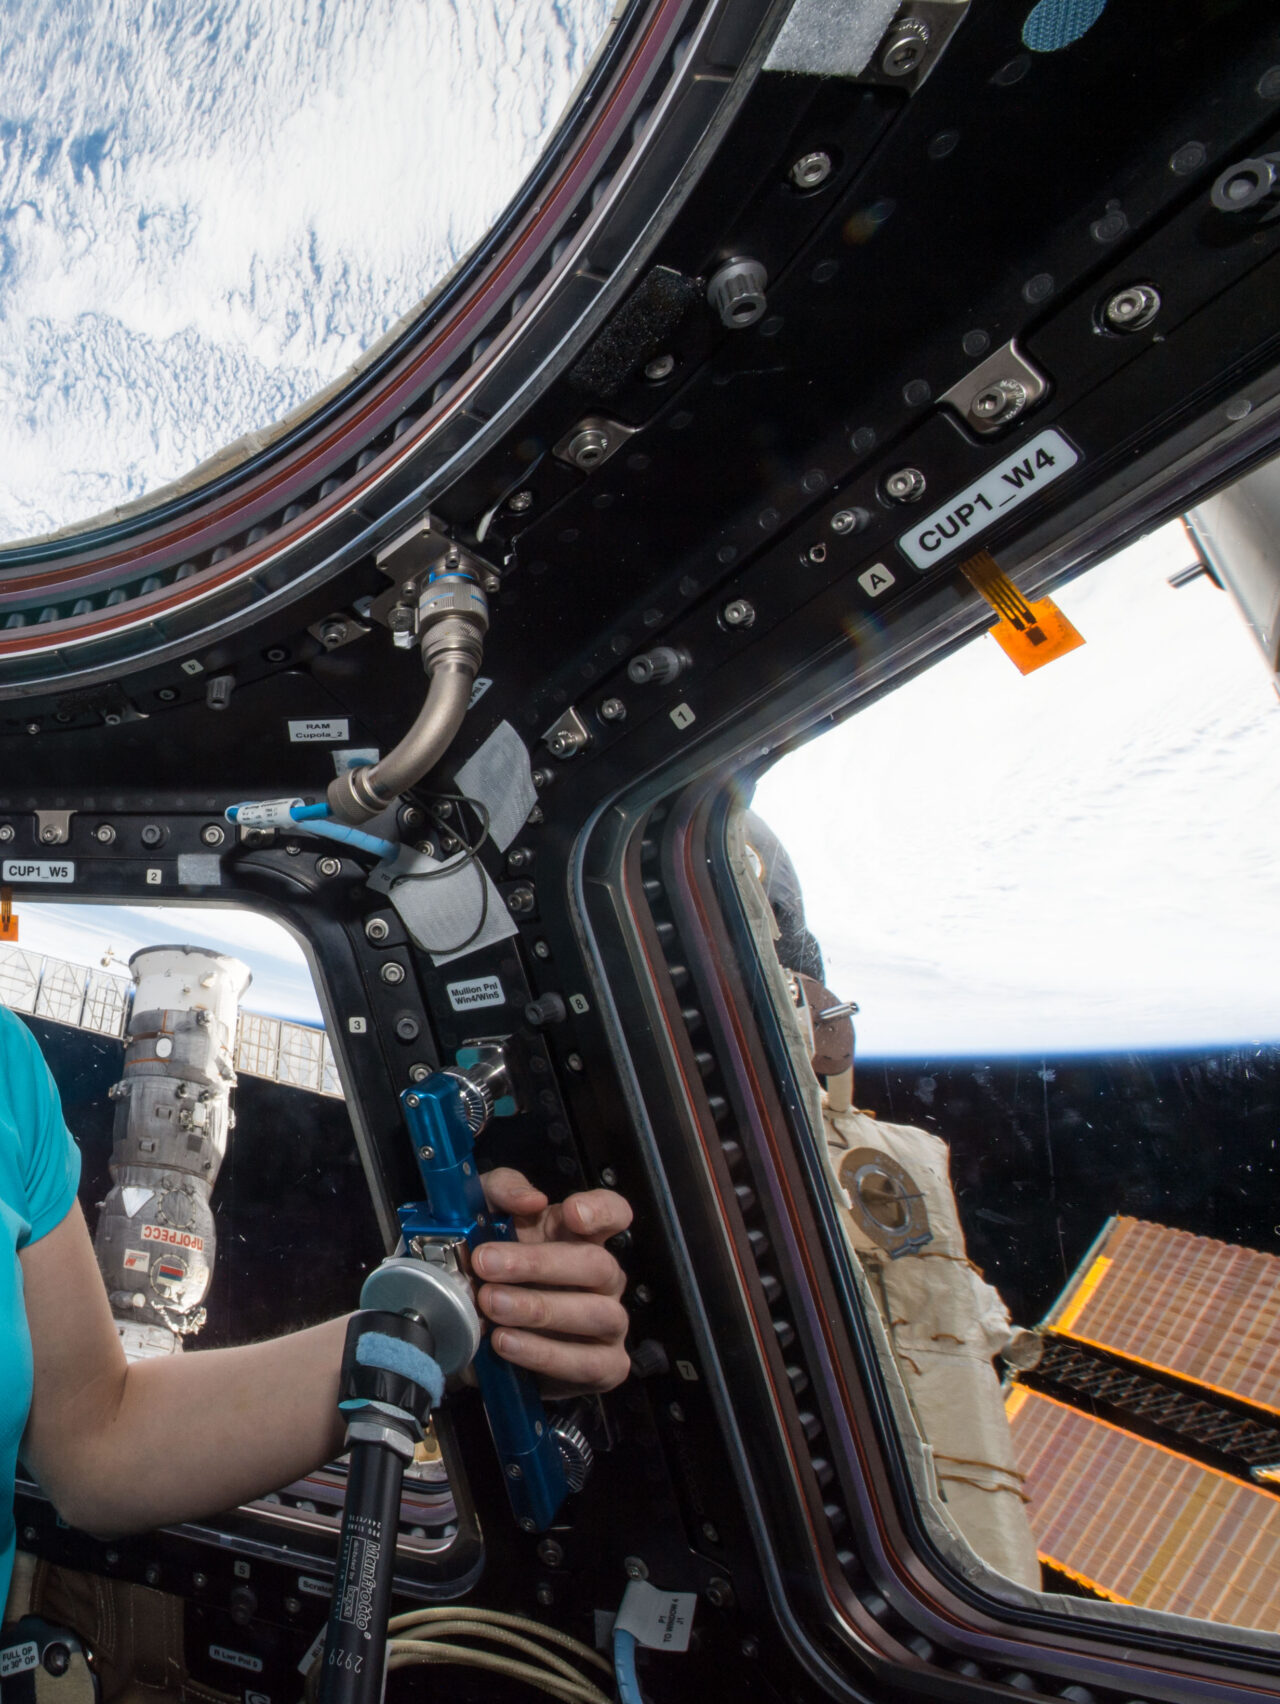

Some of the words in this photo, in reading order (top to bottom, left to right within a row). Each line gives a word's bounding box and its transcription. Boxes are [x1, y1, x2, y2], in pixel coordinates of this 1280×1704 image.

[918, 447, 1055, 552] CUP1_W4
[869, 573, 887, 590] A
[678, 710, 688, 722] 1
[295, 731, 343, 739] Cupola_2
[8, 865, 68, 879] CUP1_W5
[150, 872, 157, 881] 2
[451, 984, 482, 996] Mullion
[483, 982, 498, 991] Pnl
[454, 991, 500, 1005] Win4/Win5
[575, 998, 584, 1010] 8
[353, 1020, 361, 1030] 3
[144, 1226, 203, 1250] ПРОГРЕСС
[664, 1633, 672, 1642] TO
[2, 1650, 20, 1661] FULL
[22, 1646, 33, 1656] OP
[2, 1664, 10, 1672] or
[24, 1655, 36, 1665] OP
